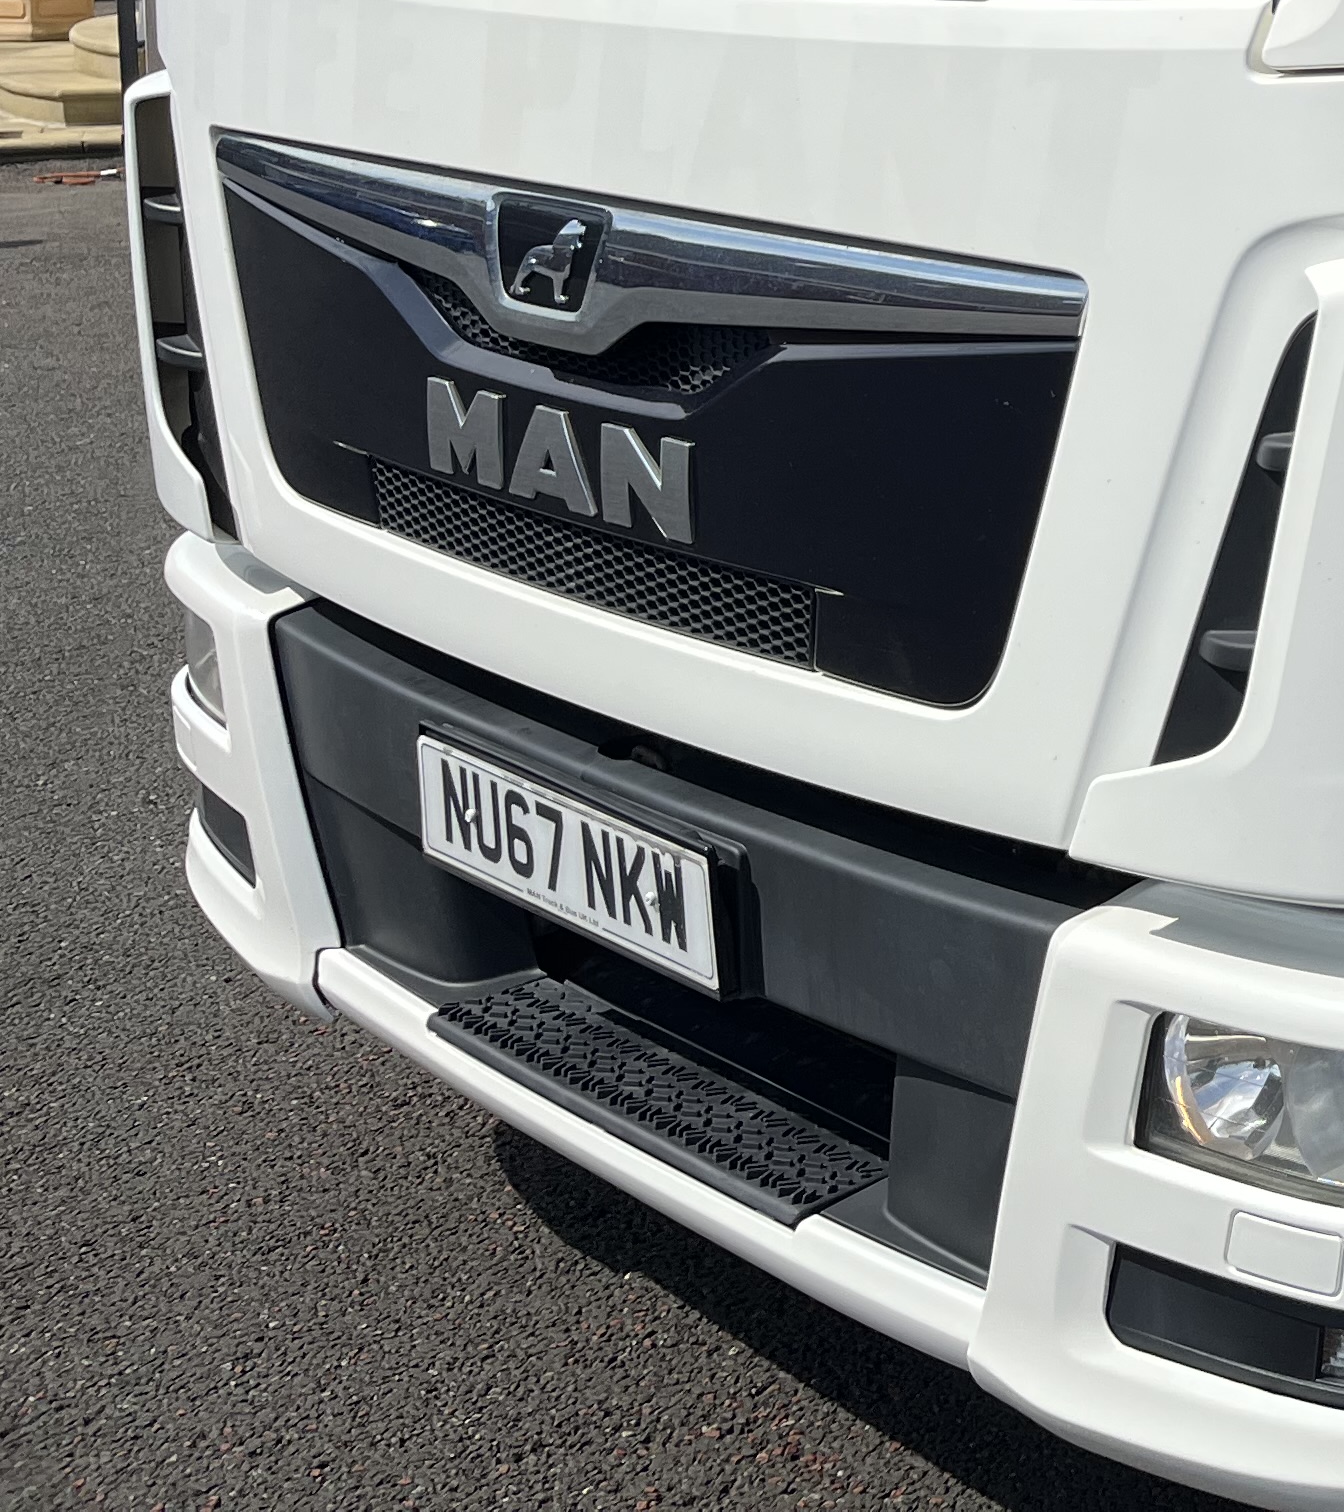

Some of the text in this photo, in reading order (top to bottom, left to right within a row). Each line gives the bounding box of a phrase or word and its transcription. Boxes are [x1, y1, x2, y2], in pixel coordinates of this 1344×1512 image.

[427, 376, 695, 545] MAN
[441, 757, 688, 953] NU67 NKW
[526, 887, 541, 900] MAN
[541, 894, 558, 908] Truck
[565, 905, 578, 917] Bus
[578, 912, 588, 923] UK
[588, 916, 599, 928] Ltd
